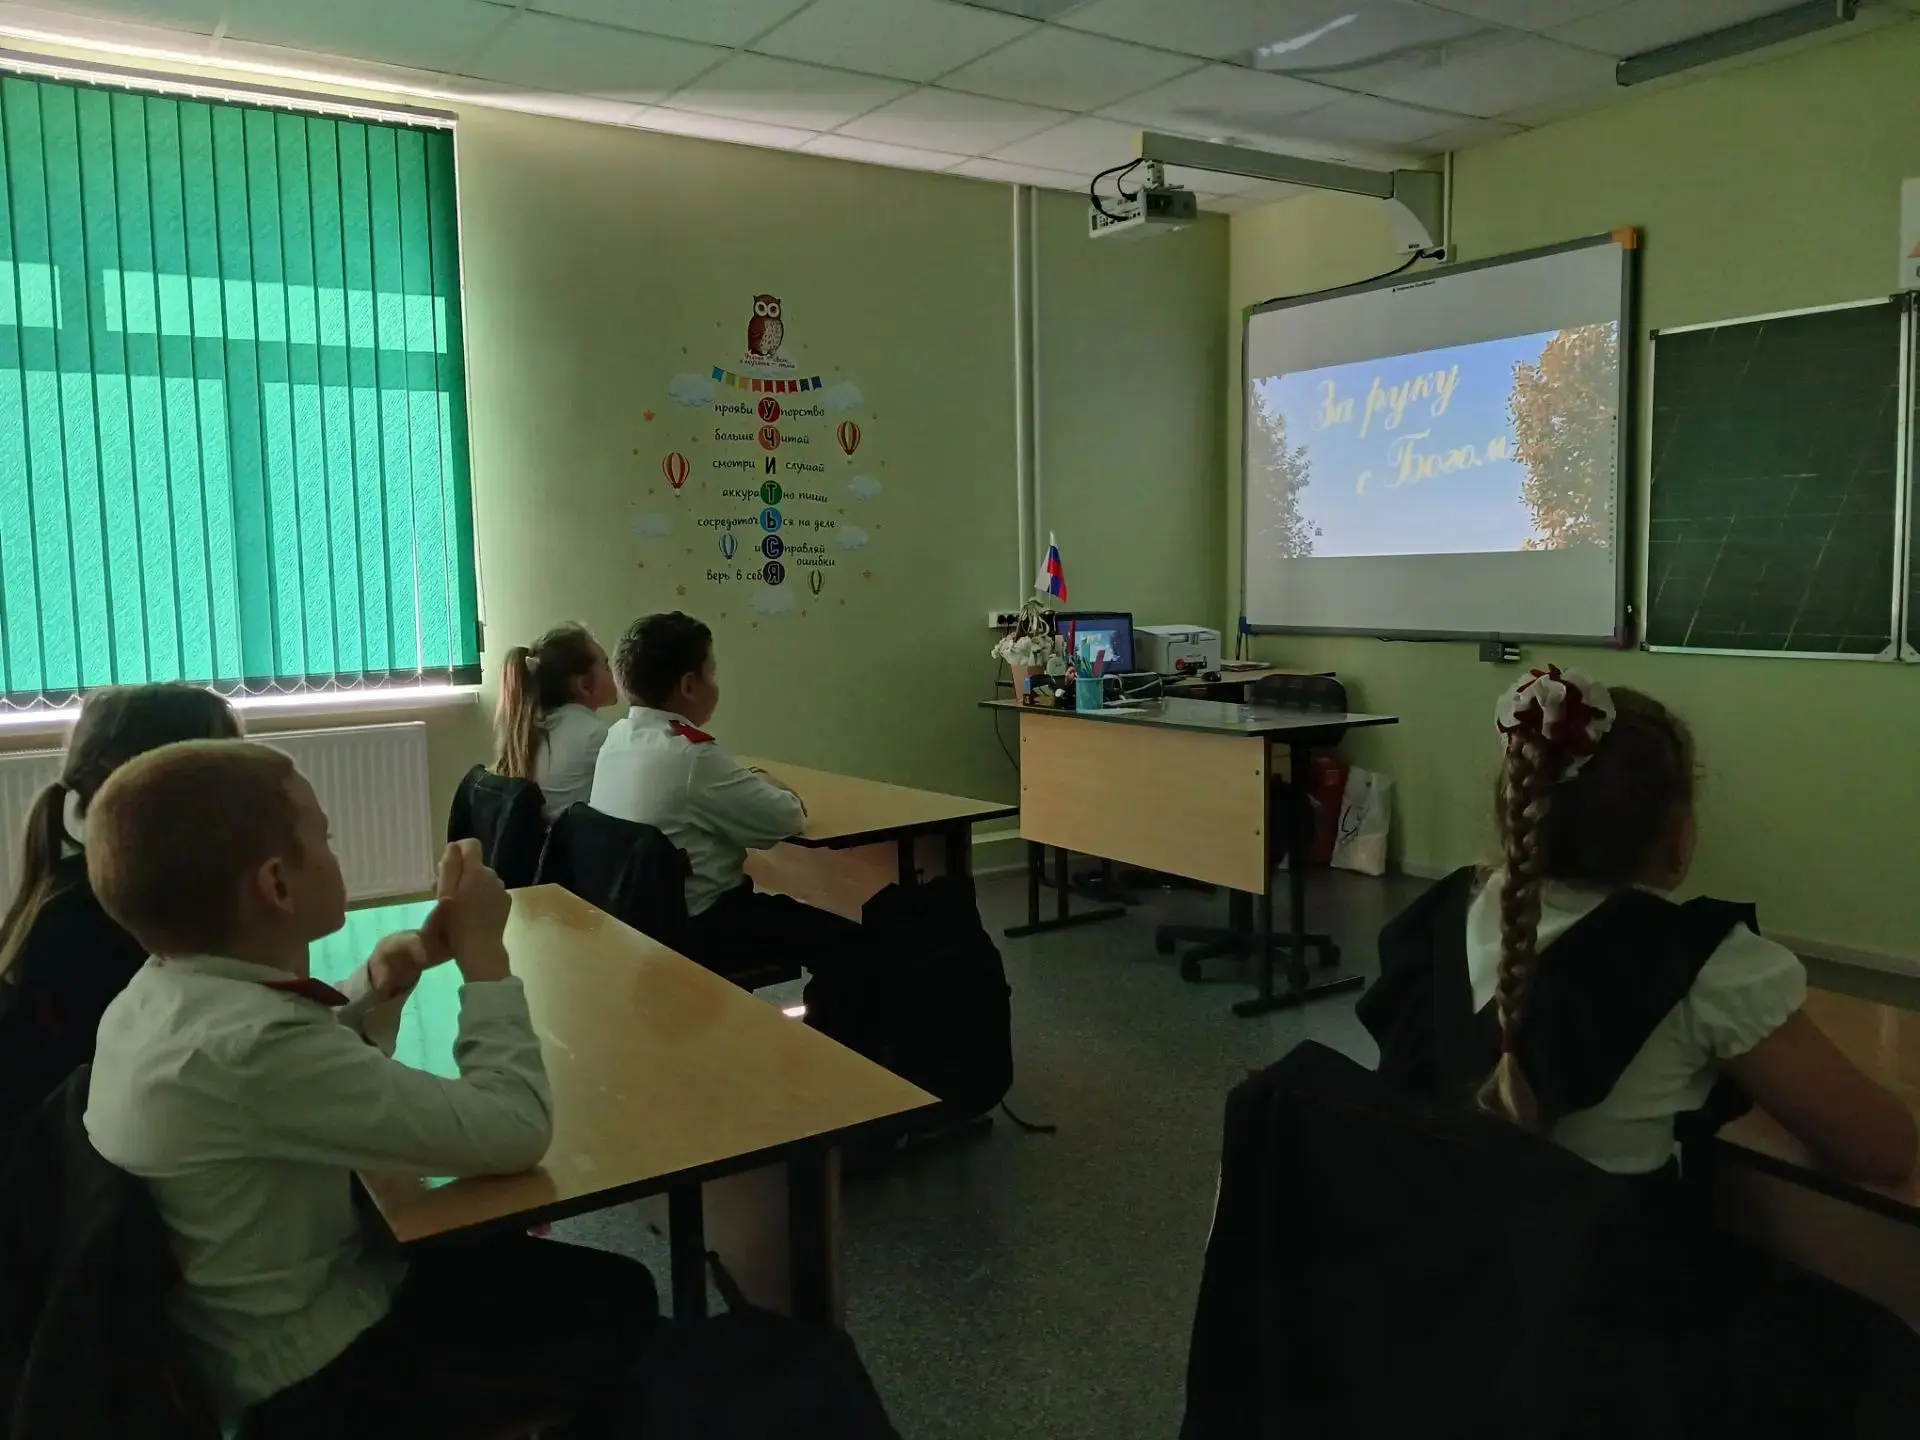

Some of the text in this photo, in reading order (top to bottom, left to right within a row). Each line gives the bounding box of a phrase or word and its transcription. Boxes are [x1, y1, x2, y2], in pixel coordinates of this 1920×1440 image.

[1310, 364, 1460, 439] За руку
[714, 403, 753, 417] прояви
[714, 428, 754, 441] больше
[712, 459, 756, 473] смотри
[785, 461, 825, 474] слушай
[1355, 469, 1374, 495] с
[798, 492, 828, 503] пиши
[798, 519, 810, 527] на
[814, 519, 836, 532] деле
[796, 555, 835, 567] ошибки
[706, 569, 730, 584] верь
